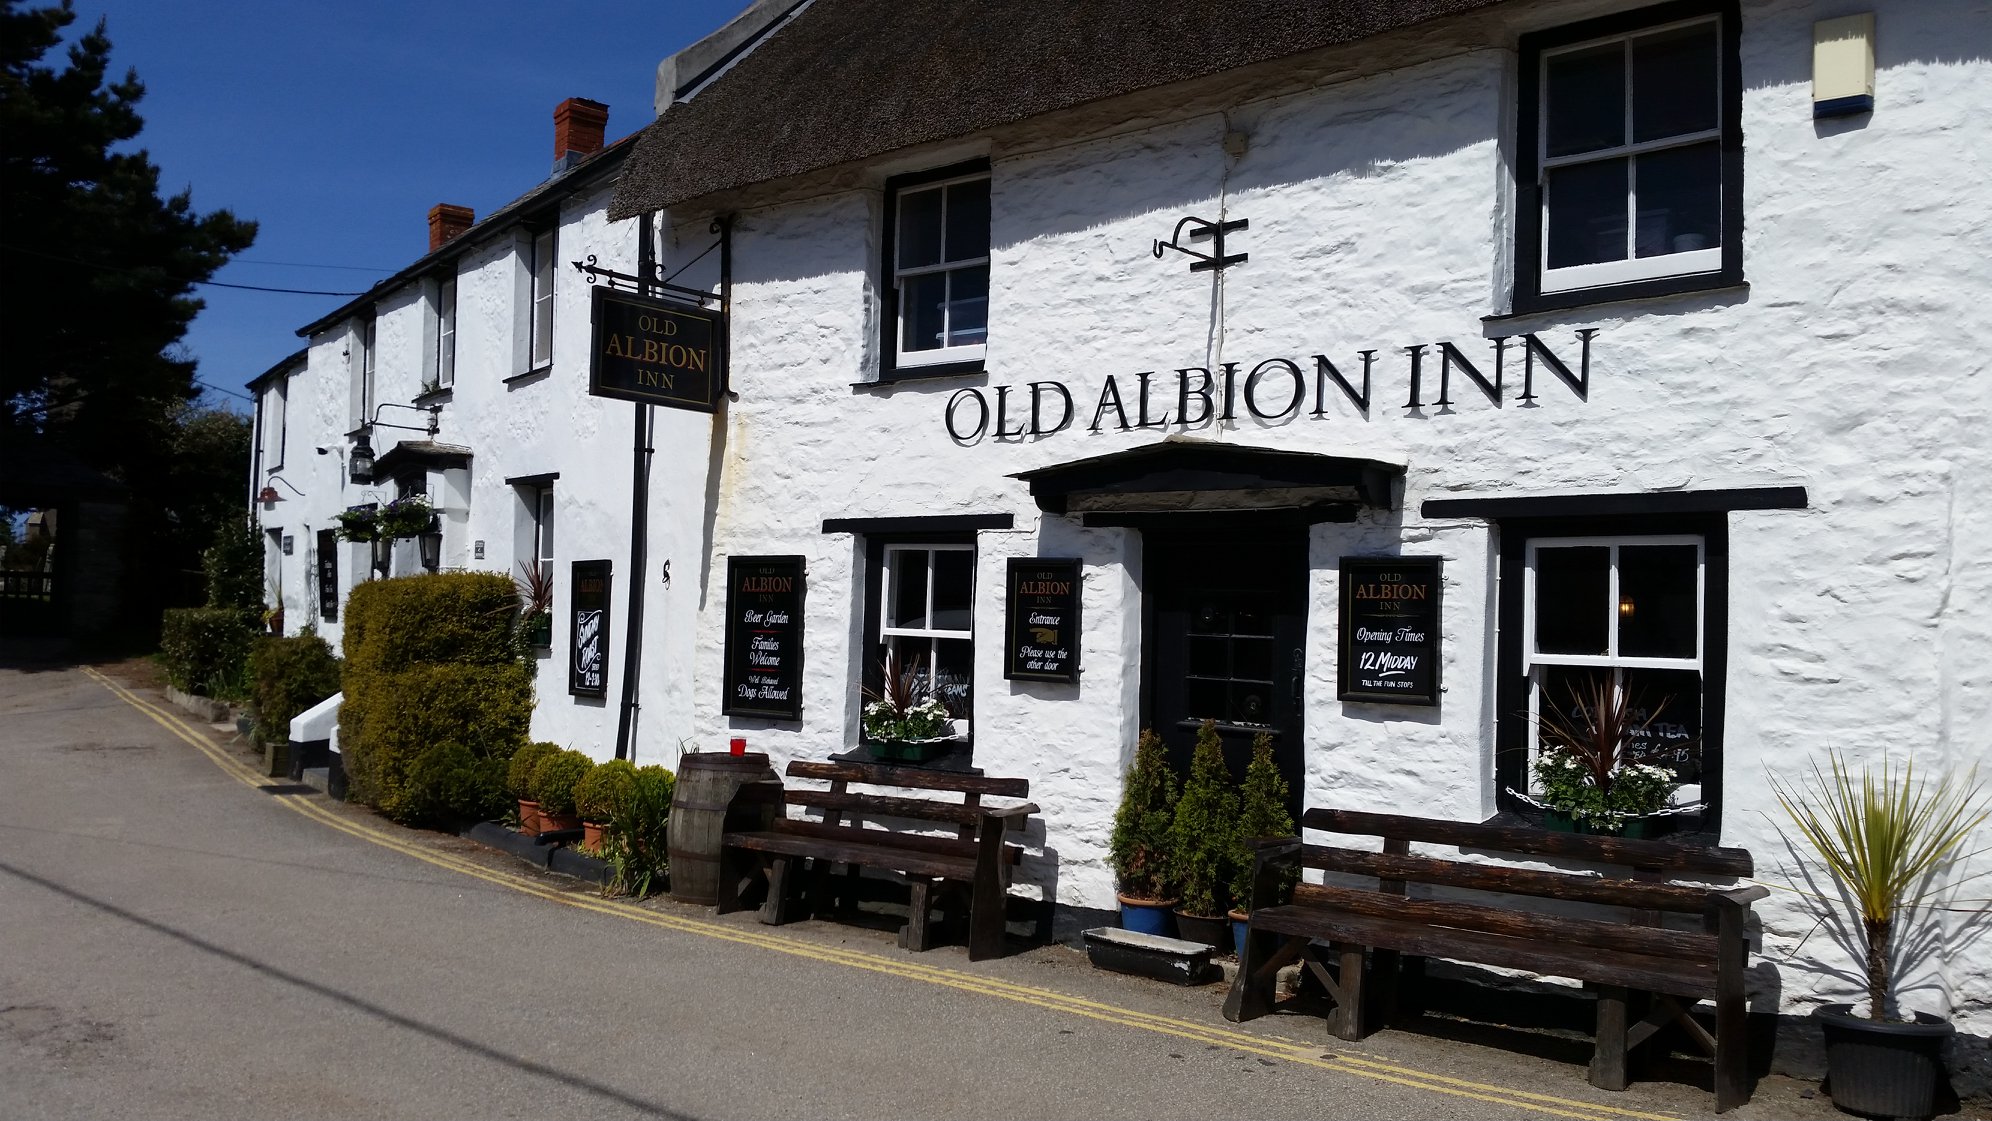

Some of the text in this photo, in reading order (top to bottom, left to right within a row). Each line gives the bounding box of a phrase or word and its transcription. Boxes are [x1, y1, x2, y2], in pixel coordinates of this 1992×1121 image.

[638, 315, 677, 336] OLD
[605, 333, 707, 373] ALBION
[637, 369, 675, 390] INN
[945, 328, 1599, 440] OLD ALBION INN
[1036, 572, 1053, 580] OLD
[1379, 573, 1402, 582] OLD
[742, 576, 793, 593] ALBION
[1020, 581, 1070, 595] ALBION
[1355, 584, 1427, 600] ALBION
[1036, 596, 1052, 604] INN
[1379, 602, 1400, 611] INN
[744, 609, 789, 627] Beer Garden
[1029, 612, 1060, 625] Entrance
[1356, 625, 1425, 644] Opening Times
[751, 635, 779, 651] Families
[750, 651, 780, 666] Welcome
[1020, 646, 1068, 660] Please use the
[1026, 659, 1060, 671] other door
[1359, 652, 1419, 672] 12 MIDDAY
[738, 683, 790, 701] Dogs Allowed
[1384, 680, 1396, 688] FUN
[1397, 681, 1414, 689] STOPS
[1653, 722, 1690, 739] TEA
